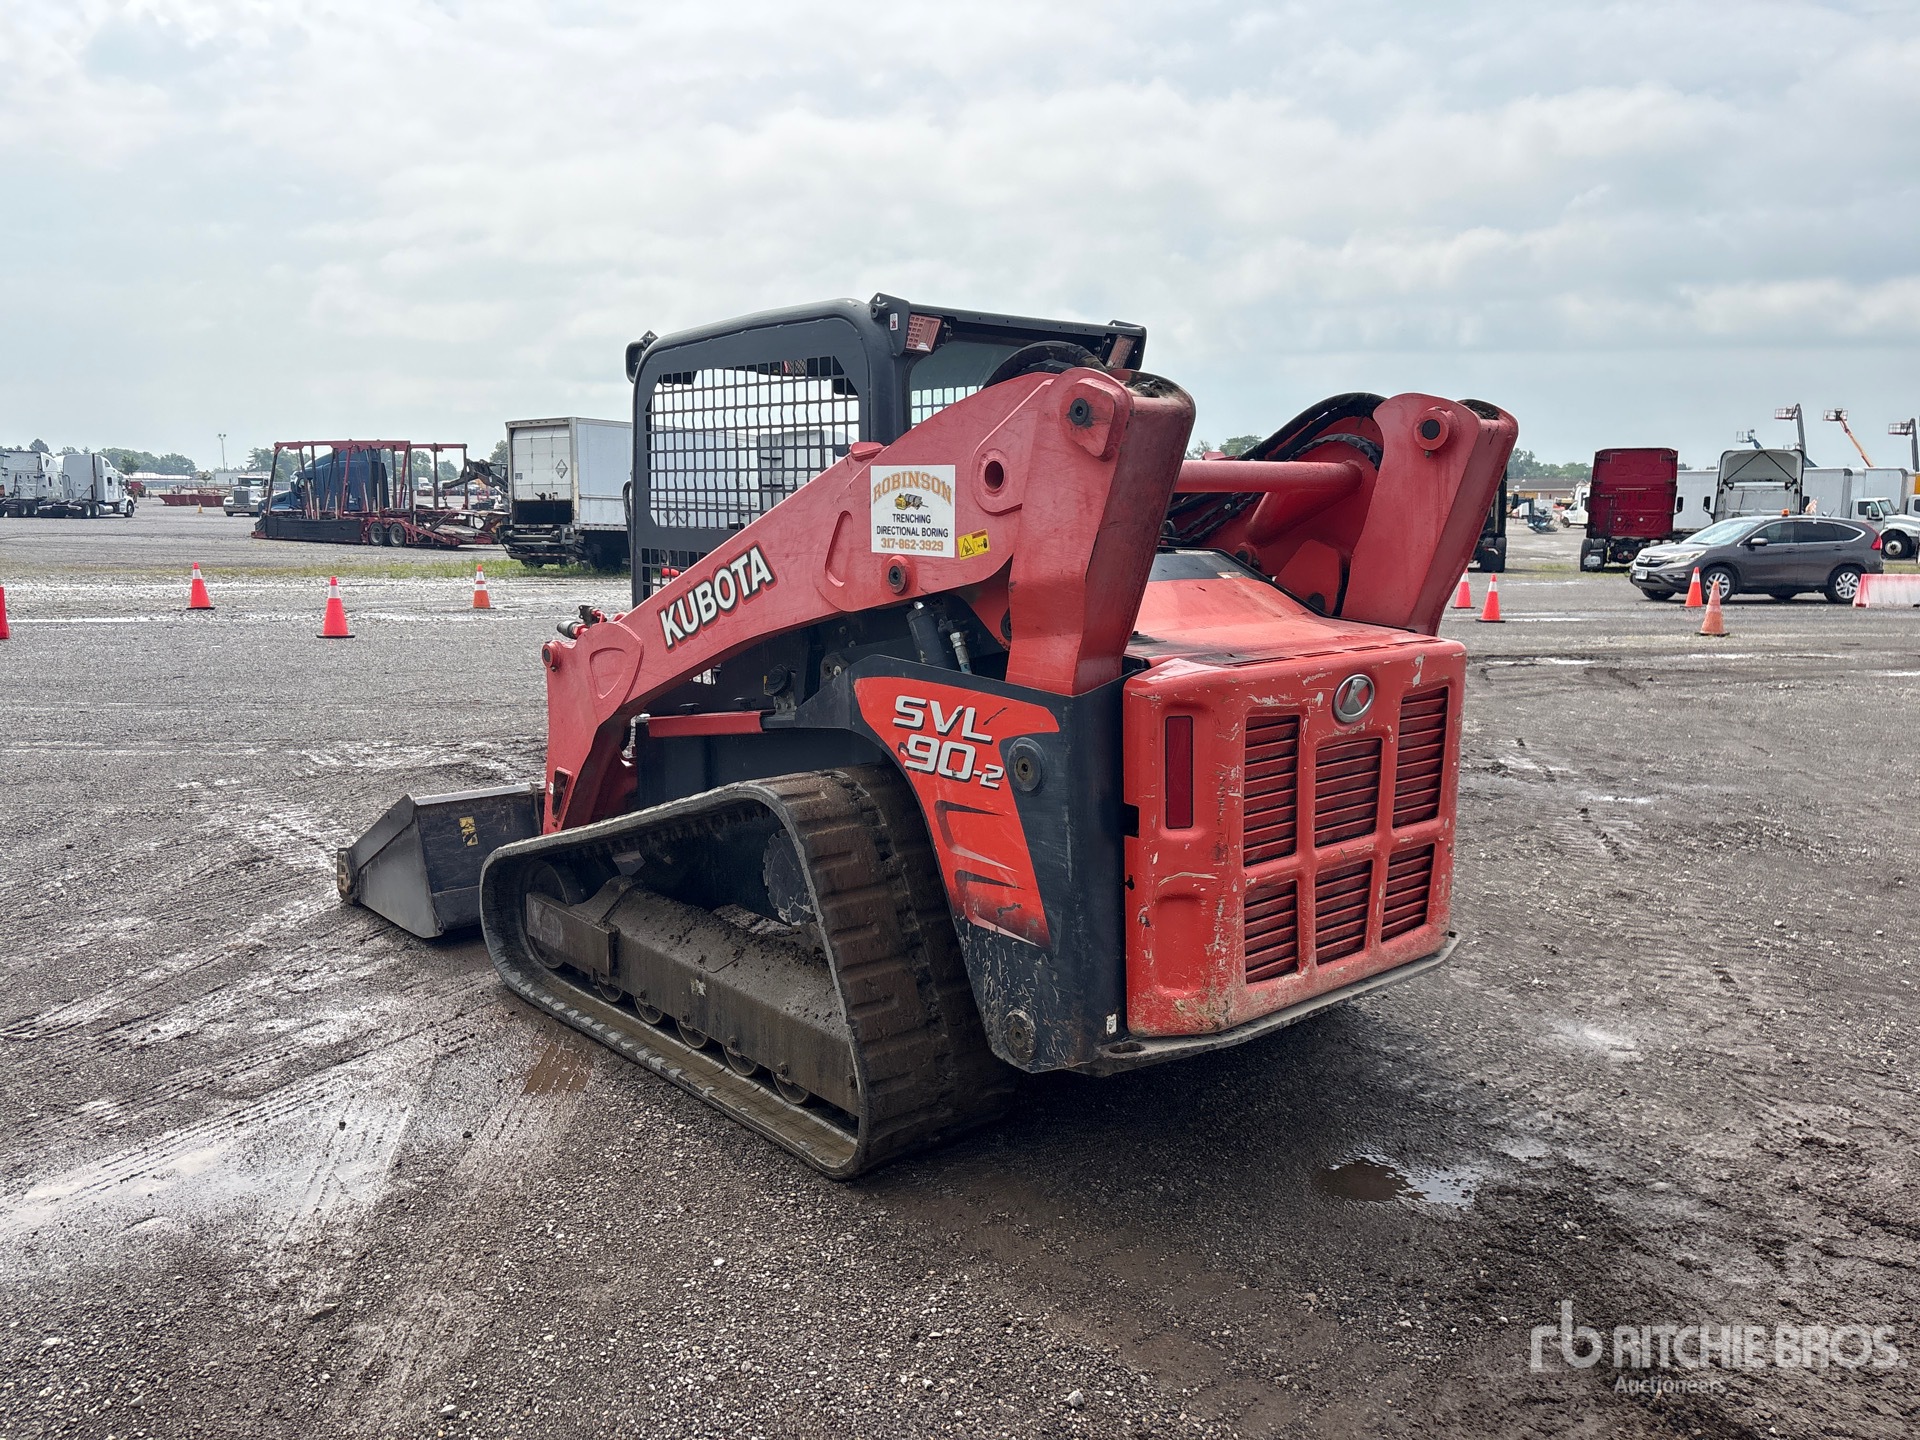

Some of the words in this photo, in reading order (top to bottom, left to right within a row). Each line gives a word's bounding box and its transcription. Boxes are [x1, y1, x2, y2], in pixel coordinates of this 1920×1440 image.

[873, 470, 952, 506] ROBINSON
[892, 513, 931, 523] TRENCHING
[877, 525, 919, 536] DIRECTIONAL
[921, 527, 948, 537] BORING
[881, 537, 943, 551] 317-862-3929
[659, 545, 775, 649] KUBOTA
[892, 694, 993, 743] SVL
